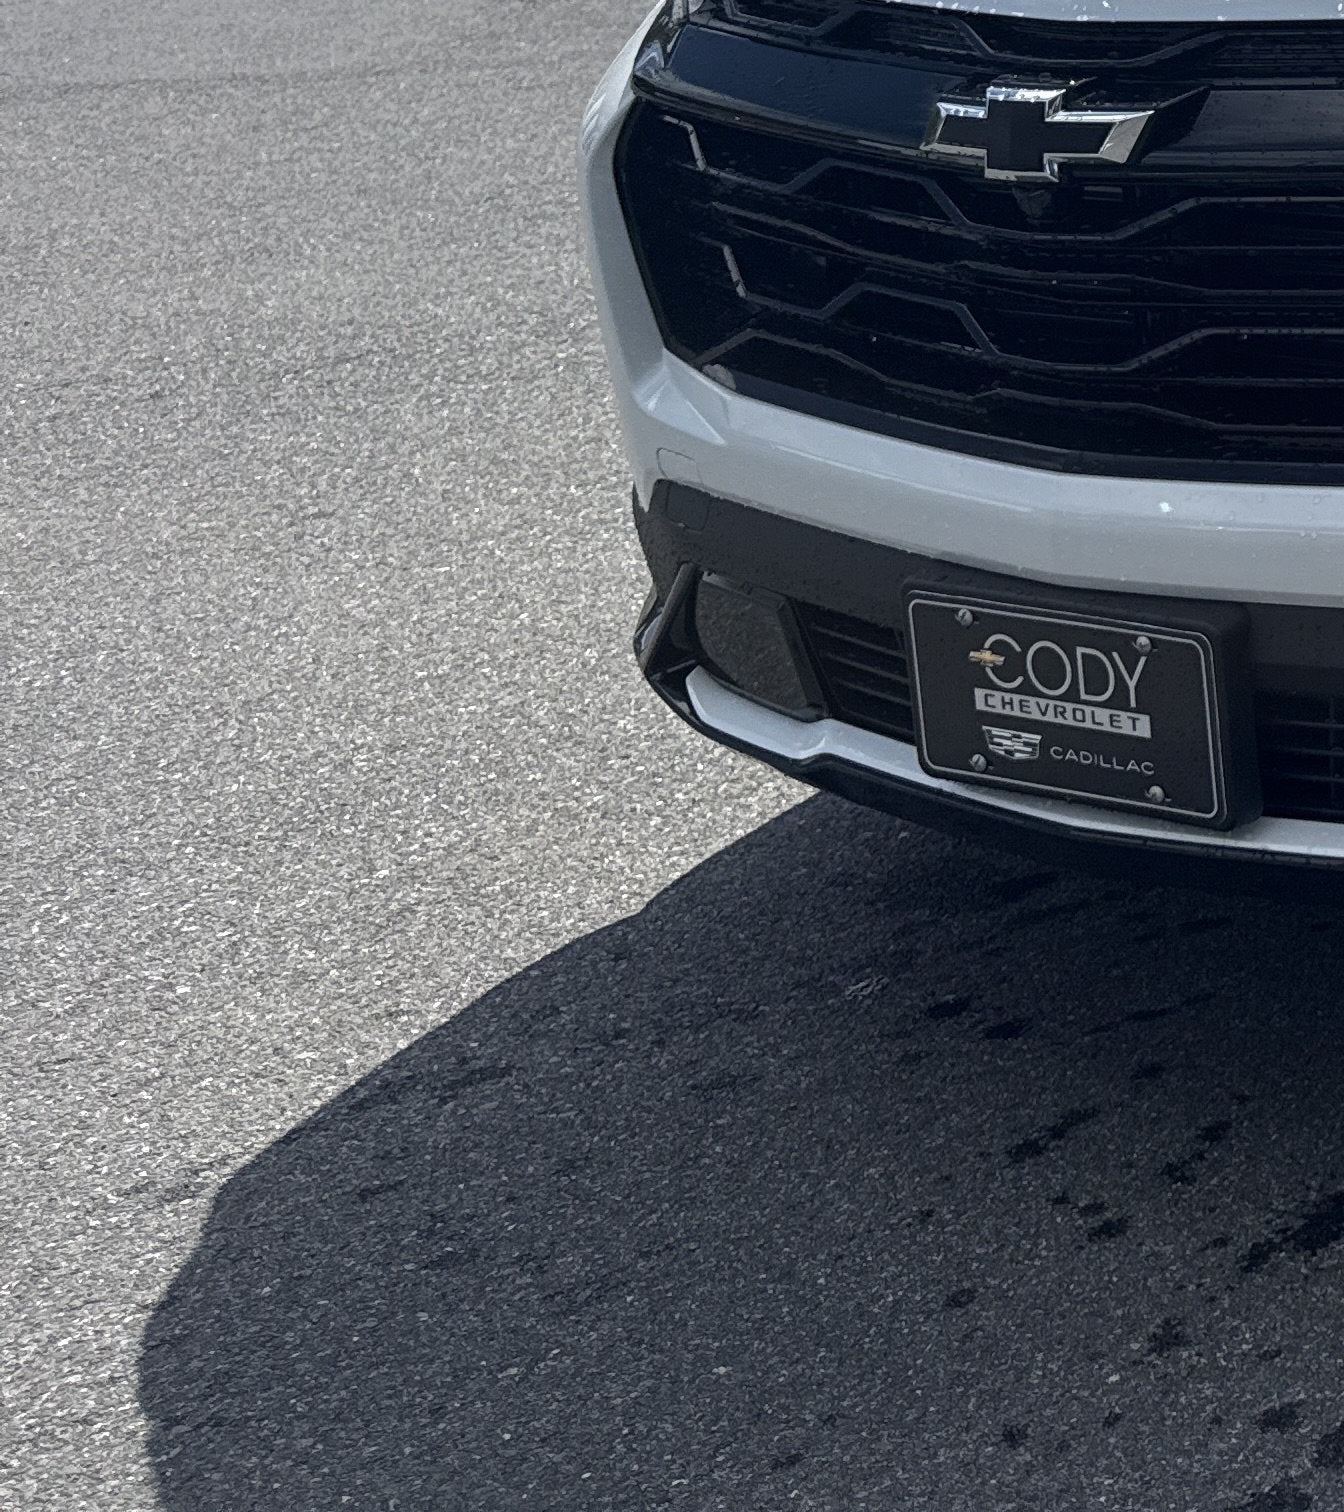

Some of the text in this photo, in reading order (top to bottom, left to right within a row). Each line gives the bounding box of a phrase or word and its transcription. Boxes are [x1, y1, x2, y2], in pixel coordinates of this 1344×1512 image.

[983, 633, 1148, 709] CODY
[983, 691, 1142, 733] CHEVROLET
[1050, 745, 1156, 777] CADILLAC
